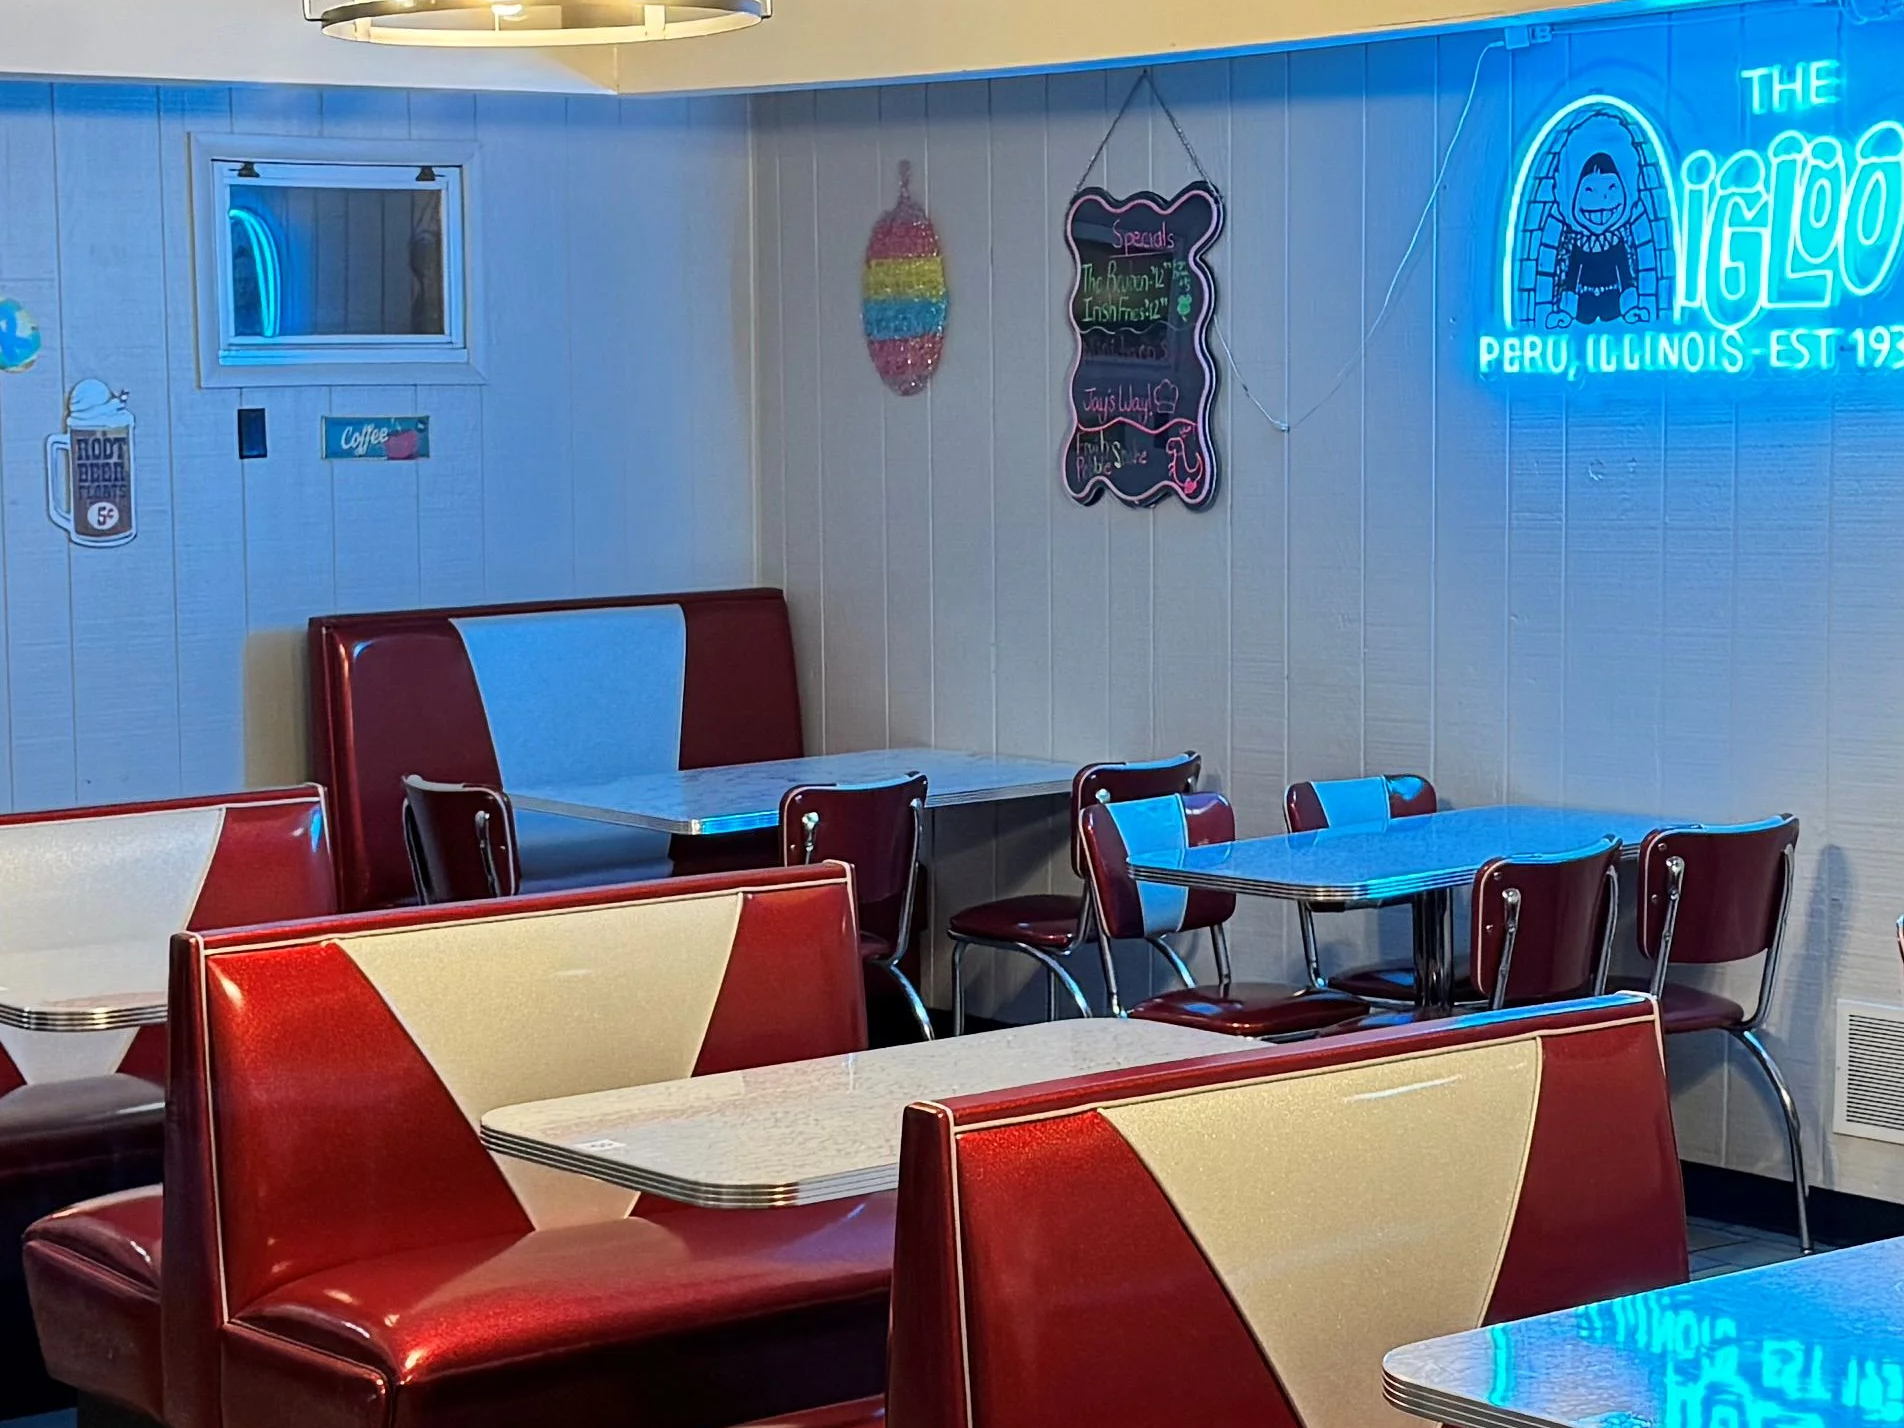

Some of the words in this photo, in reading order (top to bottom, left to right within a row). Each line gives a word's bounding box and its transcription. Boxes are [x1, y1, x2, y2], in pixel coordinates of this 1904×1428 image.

[1741, 60, 1838, 114] THE
[1112, 219, 1175, 256] Specials
[1479, 334, 1576, 380] PERU,
[1586, 329, 1744, 373] ILLINOIS
[1770, 329, 1836, 368] EST
[77, 437, 127, 461] ROOT
[341, 424, 389, 456] Coffee
[77, 461, 126, 483] BEER
